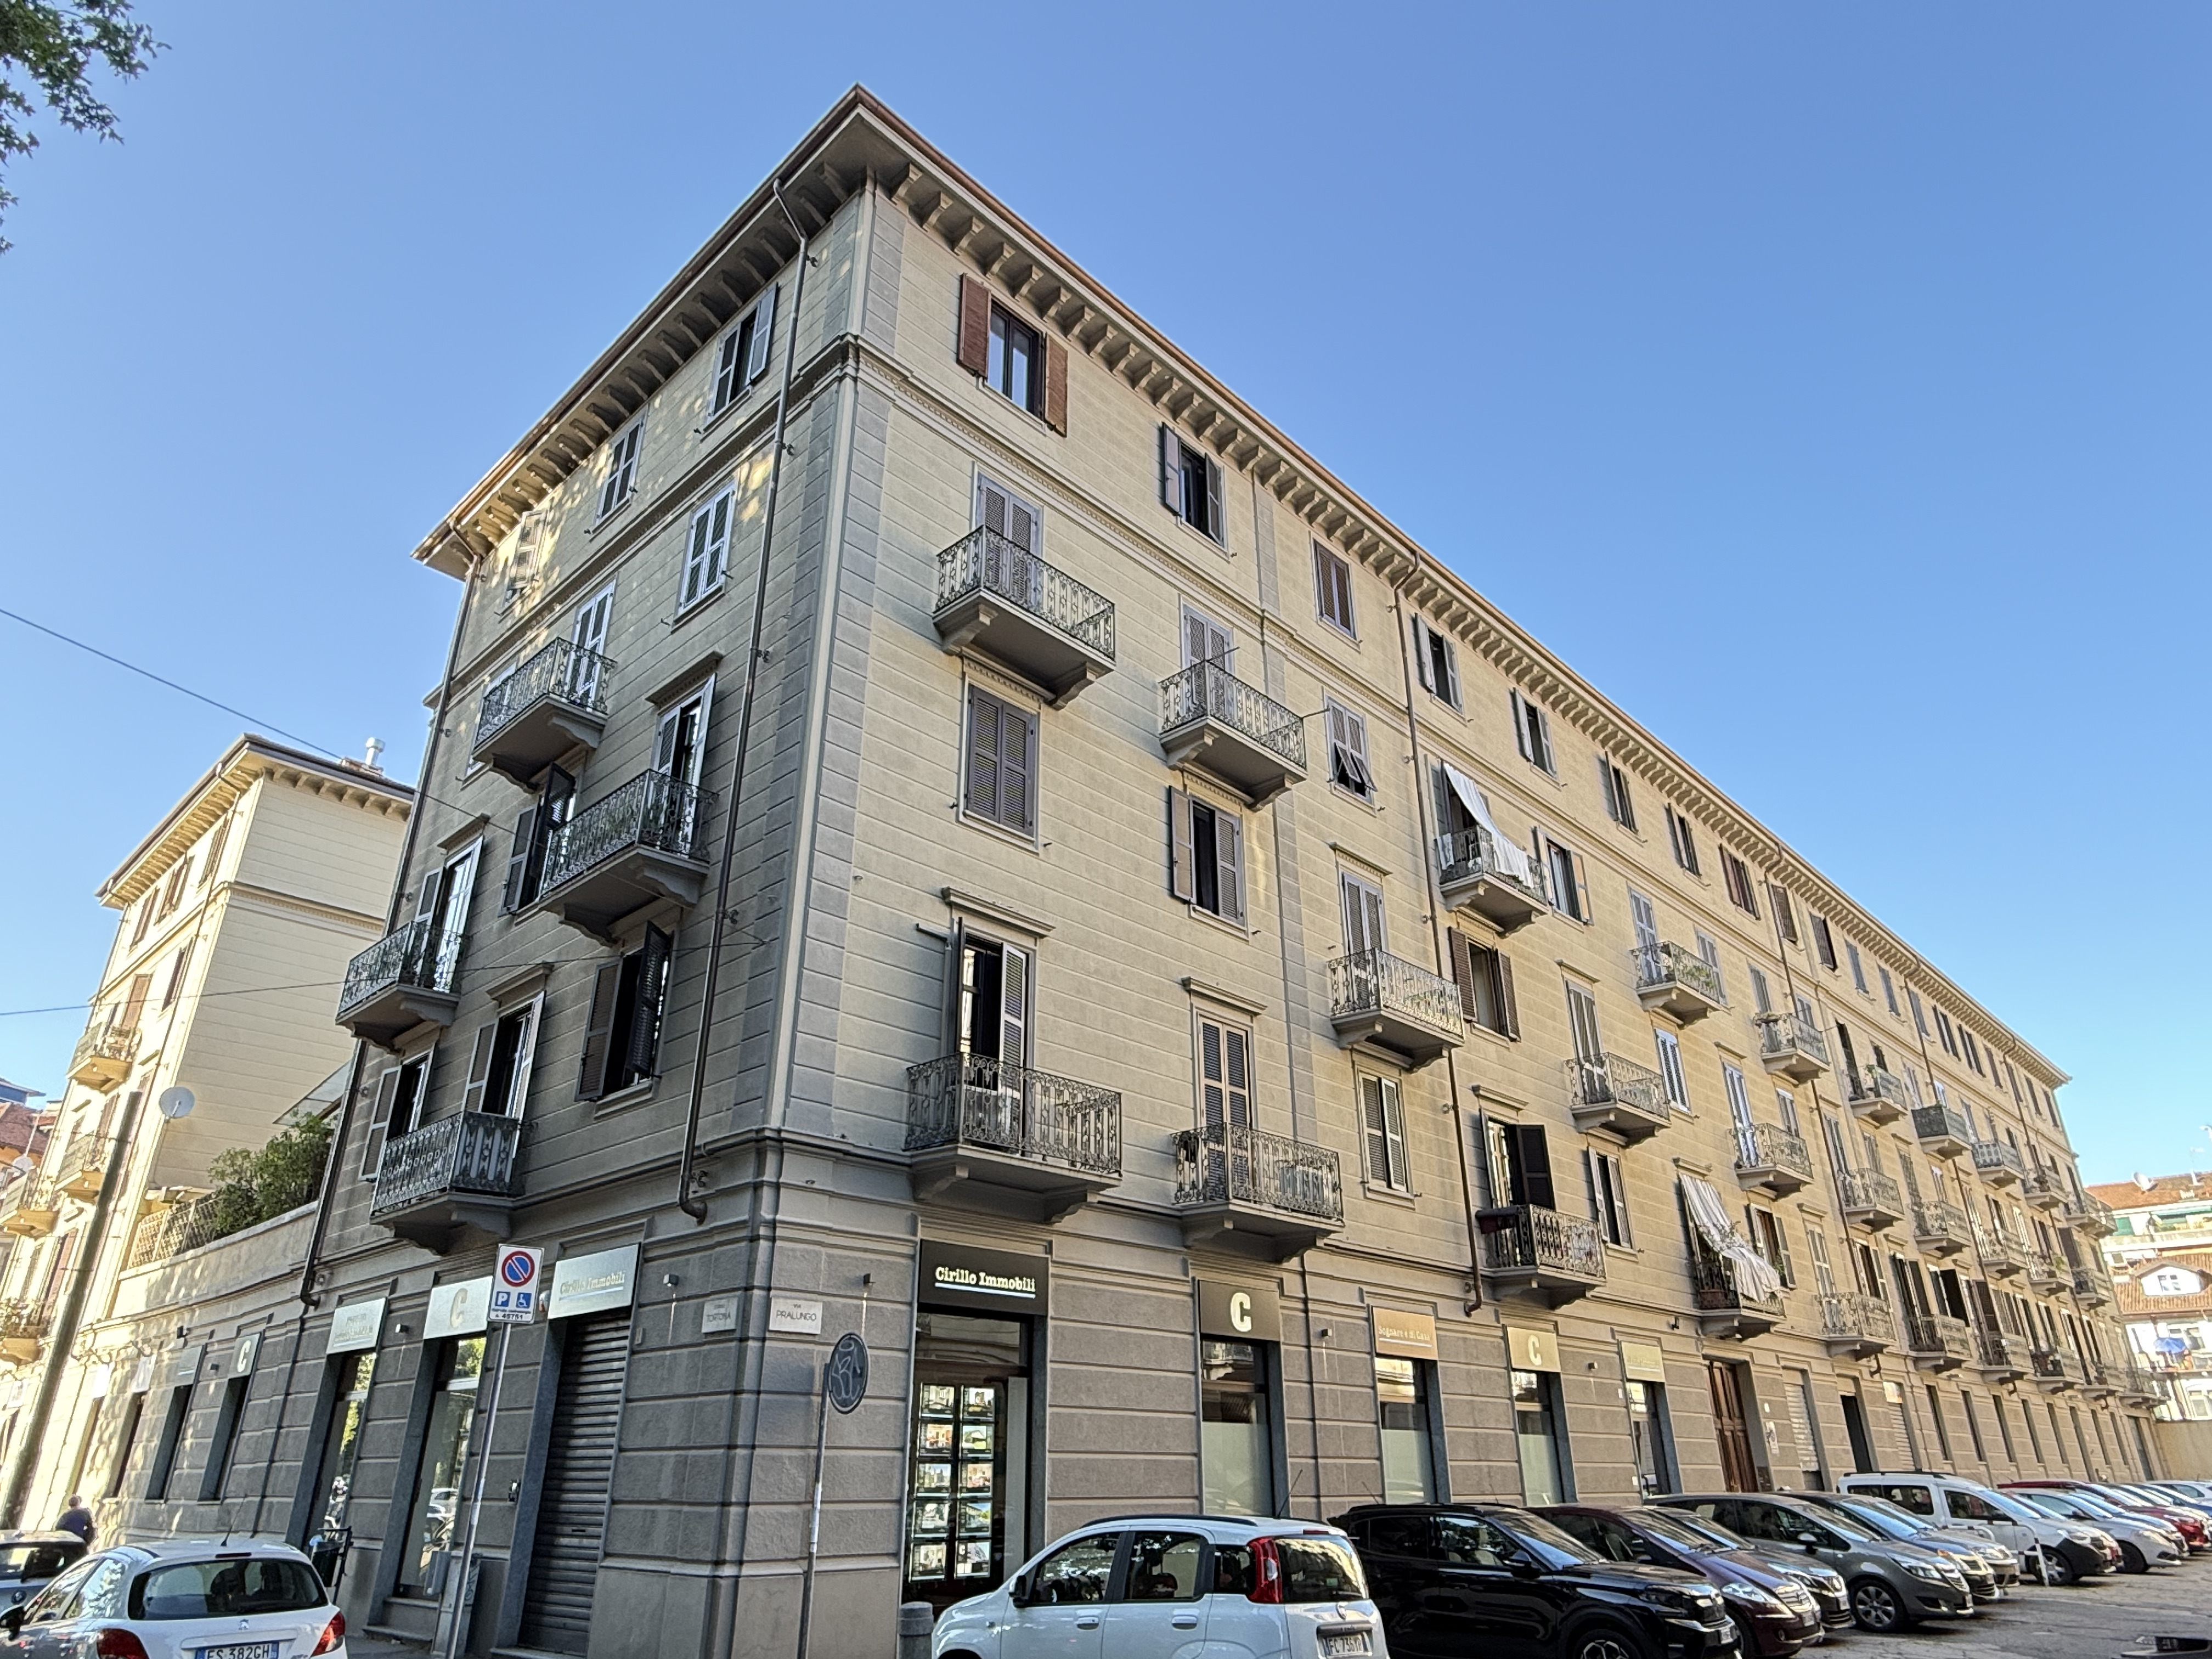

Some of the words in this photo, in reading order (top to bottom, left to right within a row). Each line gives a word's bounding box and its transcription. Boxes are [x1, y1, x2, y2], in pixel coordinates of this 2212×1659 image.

[588, 1271, 625, 1289] Immobili
[935, 1267, 977, 1285] Cirillo
[979, 1272, 1036, 1292] Immobili
[450, 1288, 468, 1328] C
[497, 1293, 508, 1306] P
[776, 1309, 816, 1322] PRALUNGO
[1230, 1293, 1252, 1332] C
[237, 1340, 251, 1373] C
[1528, 1334, 1542, 1366] C
[229, 1645, 270, 1659] 382GH
